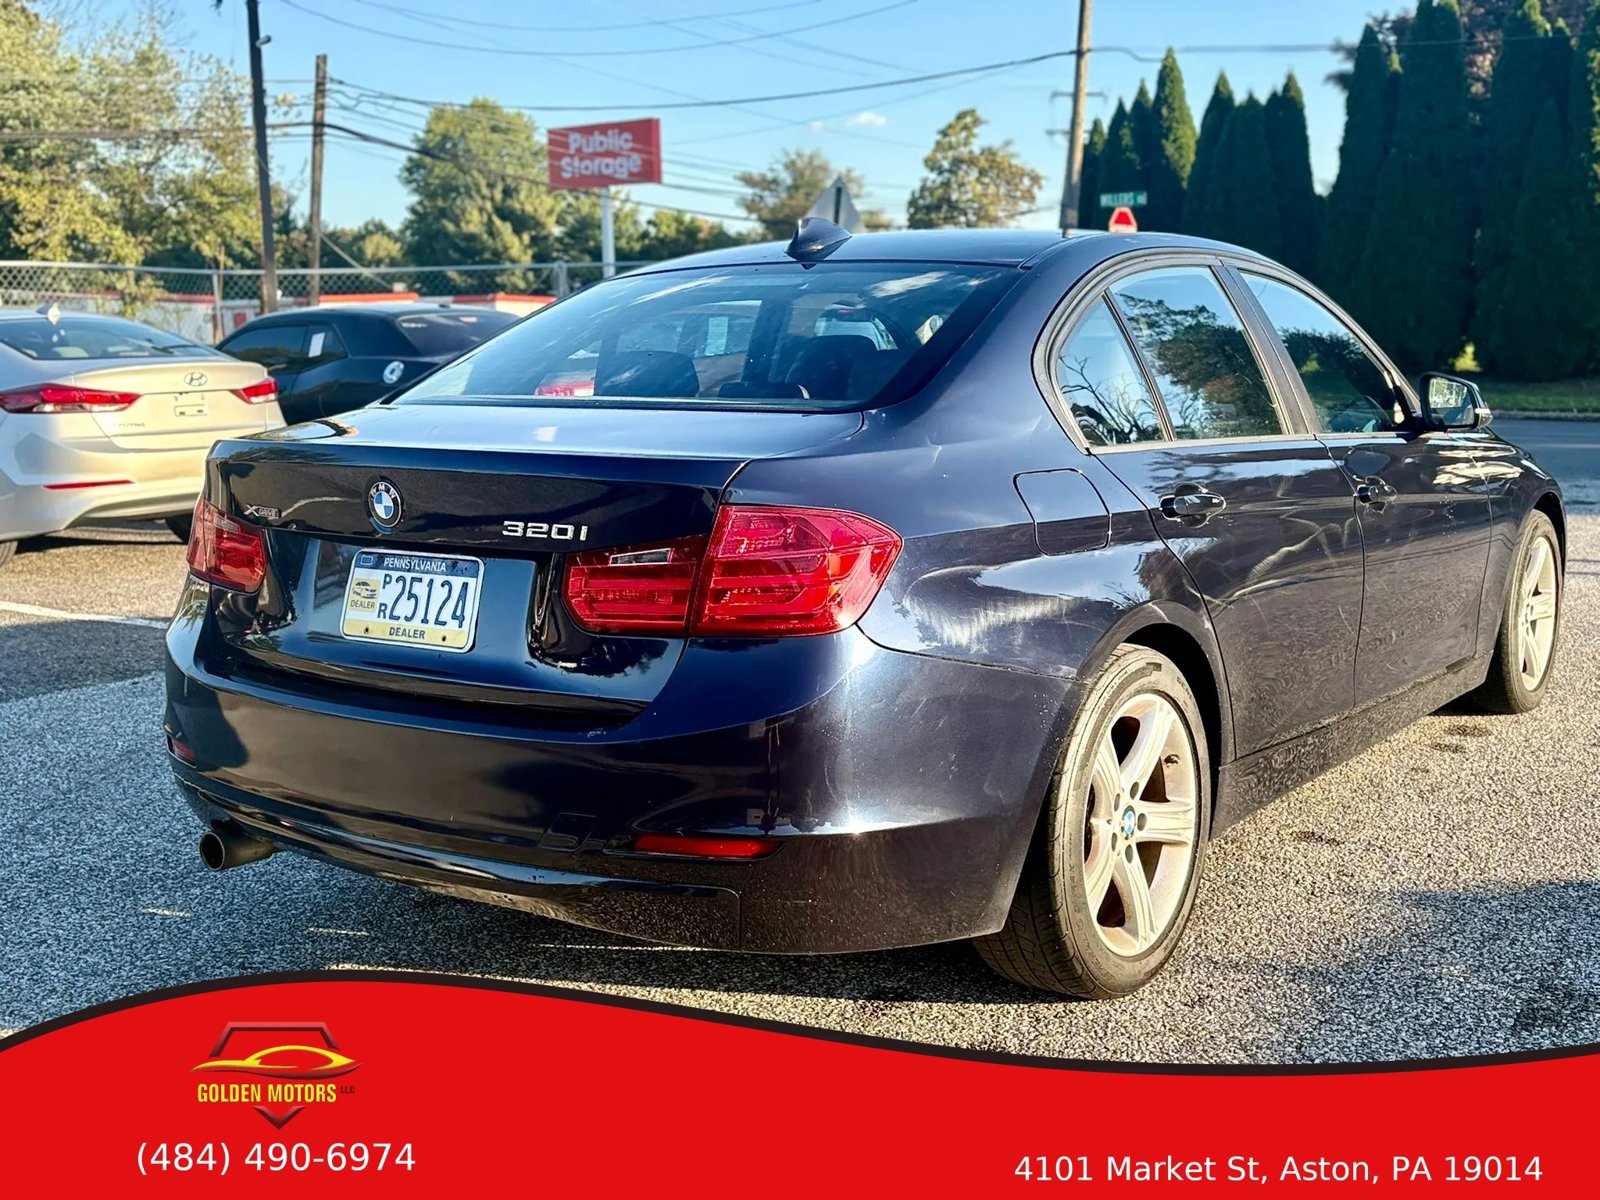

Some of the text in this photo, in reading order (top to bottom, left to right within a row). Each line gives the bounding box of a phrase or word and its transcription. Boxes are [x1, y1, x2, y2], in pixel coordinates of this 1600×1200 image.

[568, 129, 633, 153] Public
[561, 155, 642, 178] Storage
[384, 557, 447, 573] PENNSYLVANIA
[350, 599, 375, 610] DEALER
[388, 575, 469, 628] 25124
[388, 626, 426, 640] DEALER
